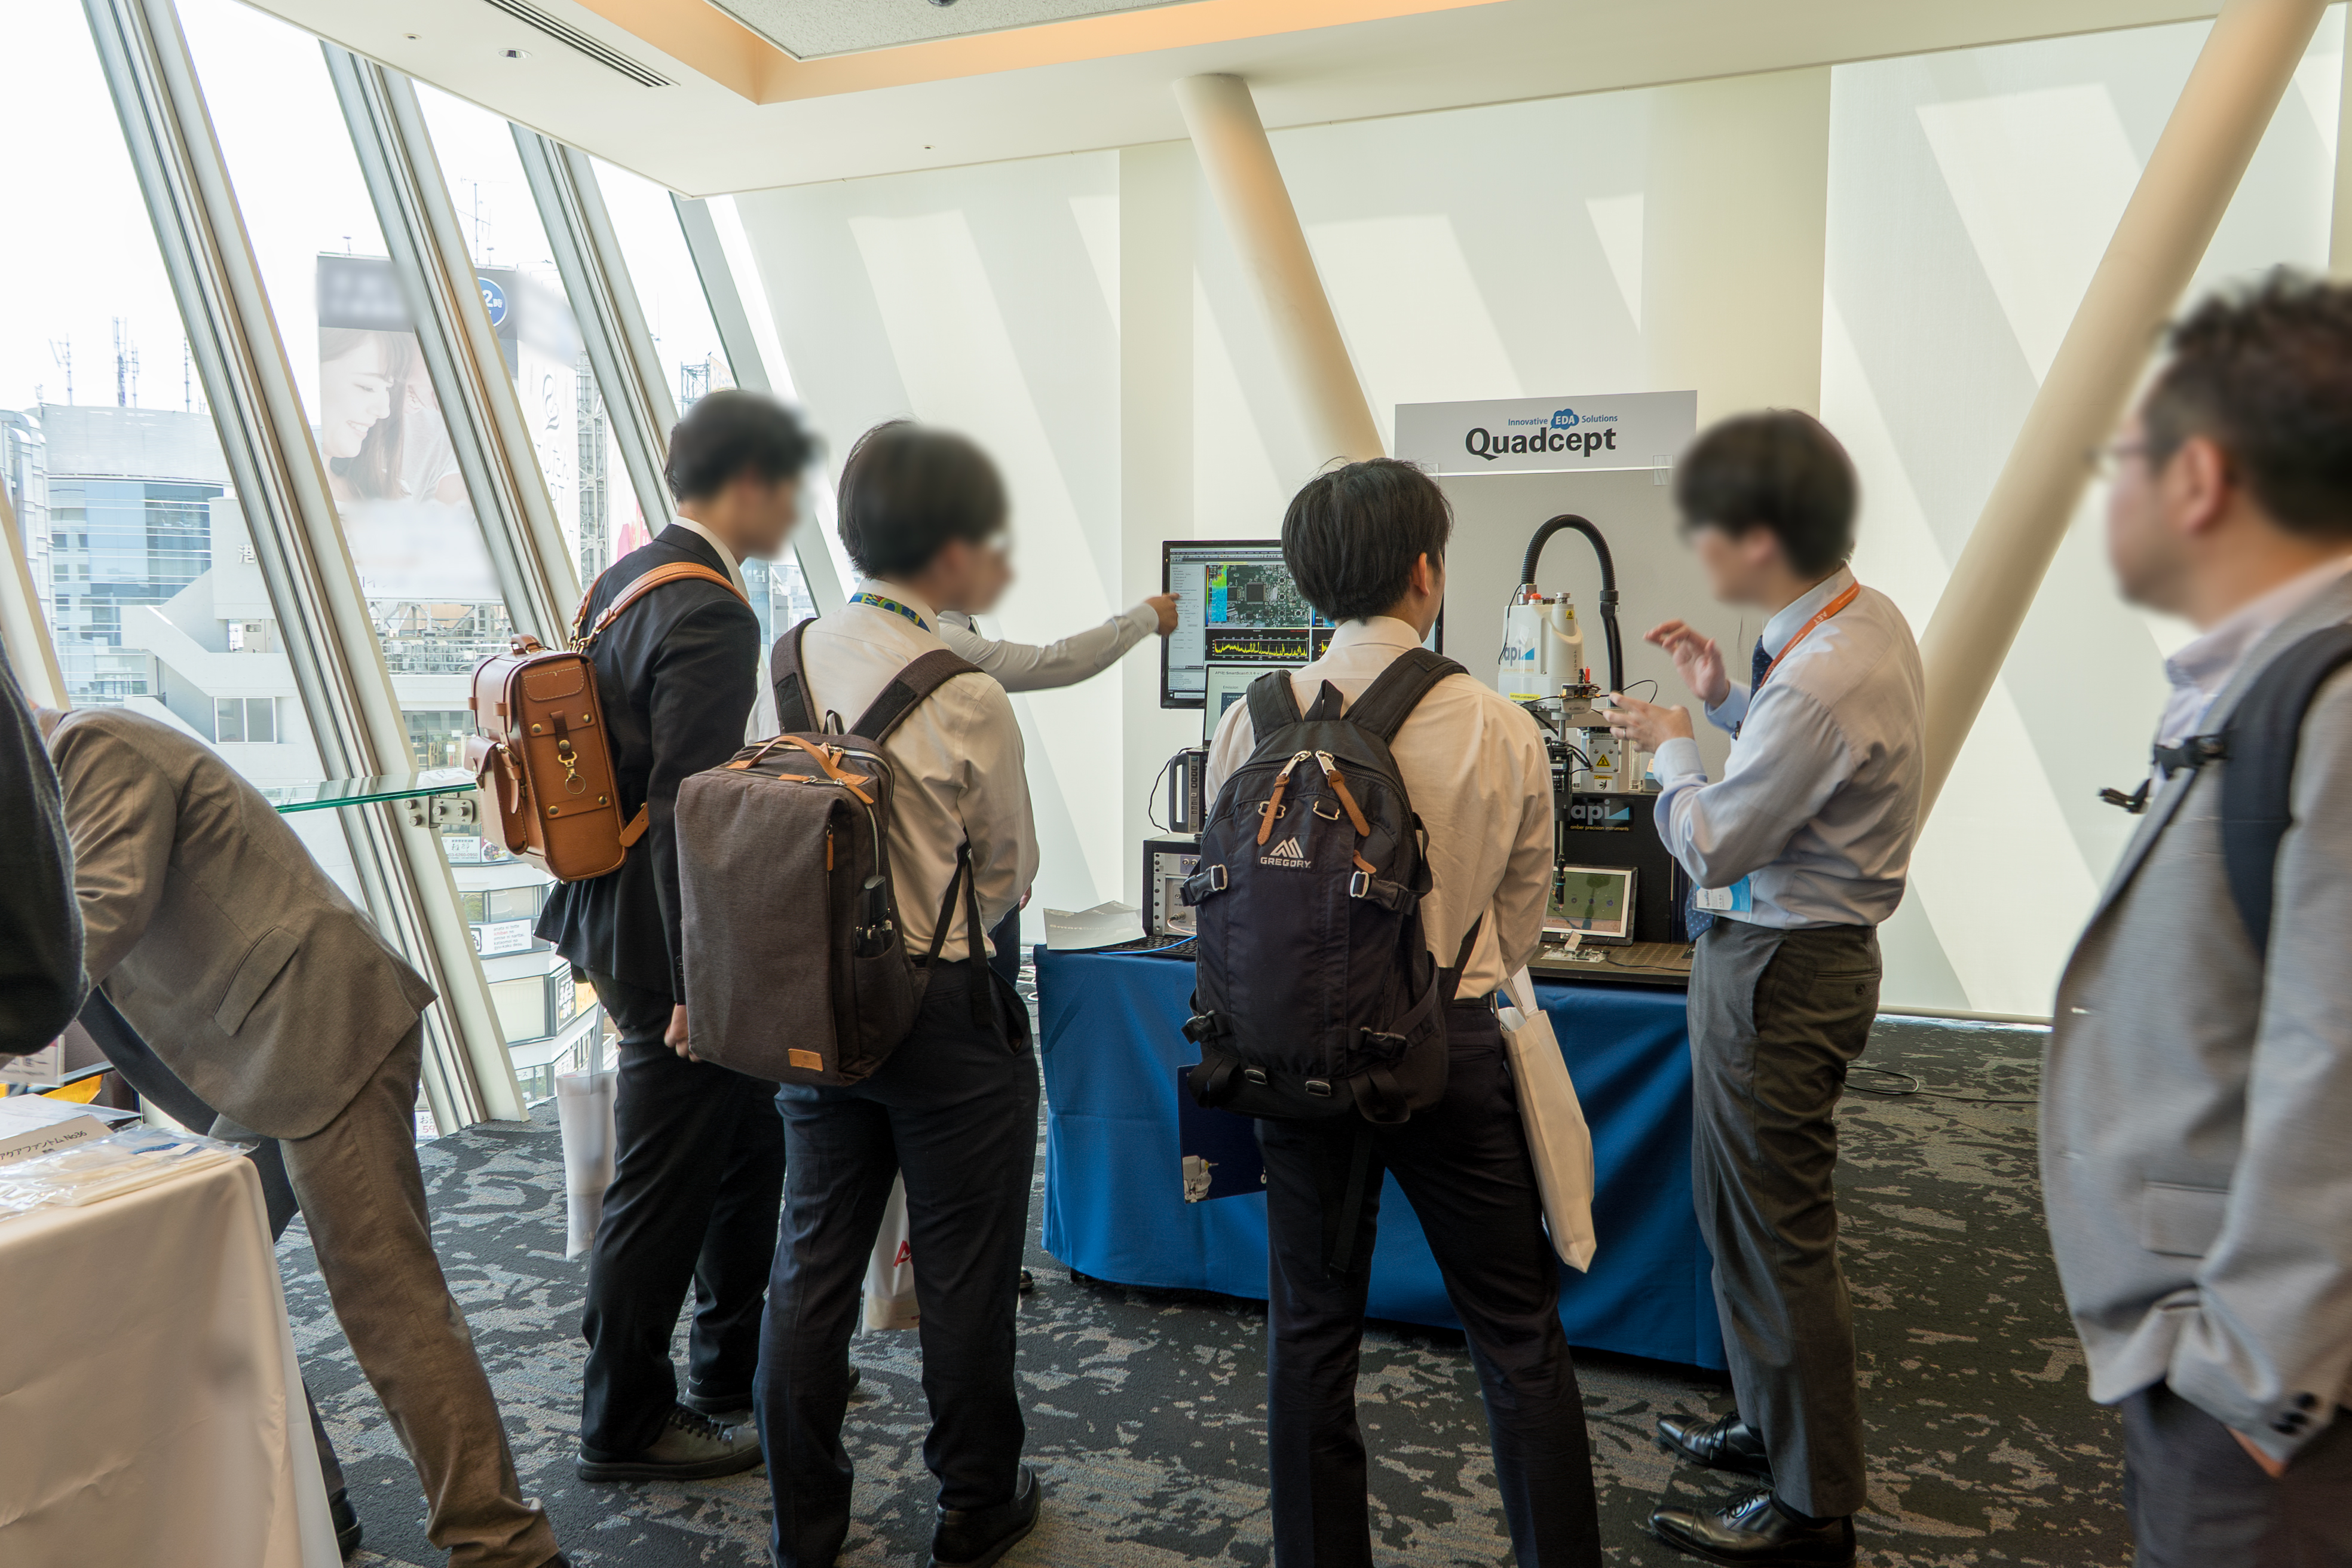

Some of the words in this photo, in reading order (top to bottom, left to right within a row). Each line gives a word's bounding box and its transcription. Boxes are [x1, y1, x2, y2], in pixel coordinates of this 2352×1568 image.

[1555, 415, 1575, 425] EDA
[1581, 415, 1618, 423] Solutions
[1465, 427, 1616, 461] Quadcept
[1813, 611, 1827, 626] AET
[1570, 799, 1610, 825] api
[1260, 856, 1311, 868] GREGORY
[63, 1131, 87, 1141] No36
